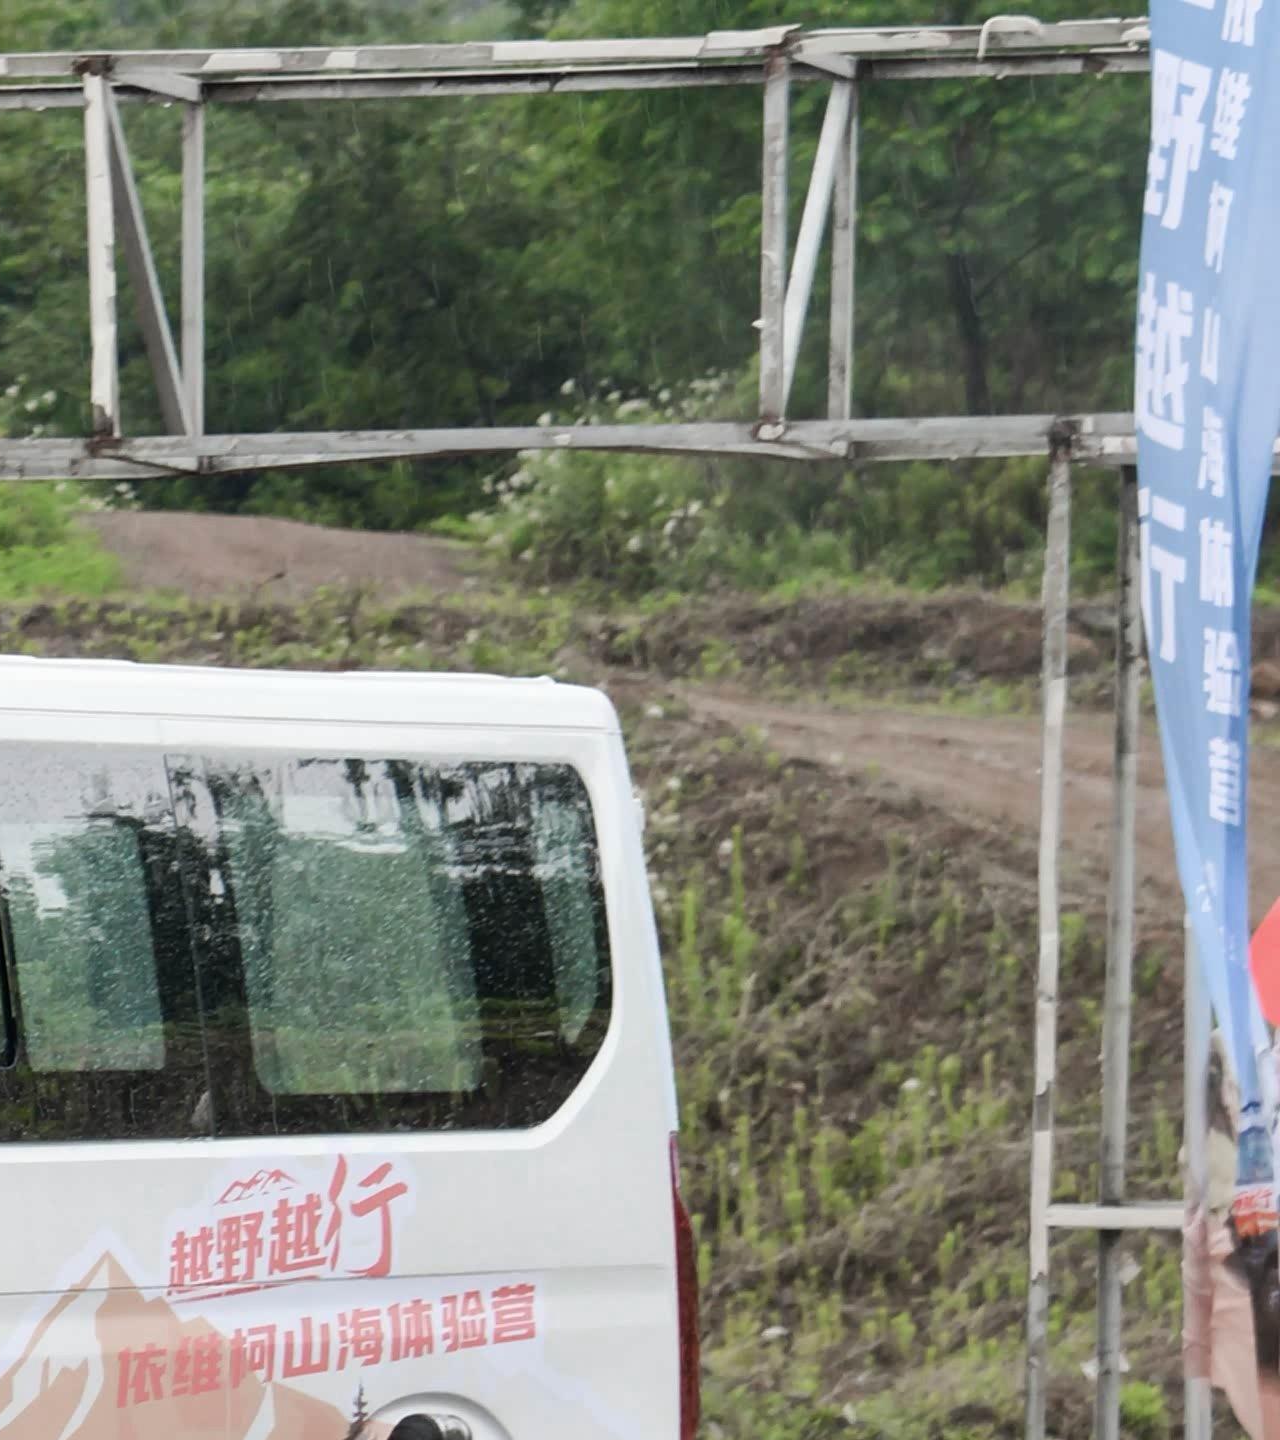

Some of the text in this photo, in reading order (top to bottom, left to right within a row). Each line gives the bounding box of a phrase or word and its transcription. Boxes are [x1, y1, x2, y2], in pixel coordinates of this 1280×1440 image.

[1135, 0, 1215, 663] 野越行
[167, 1153, 408, 1297] 越野越行
[116, 1283, 537, 1408] 依维柯山海体验营
